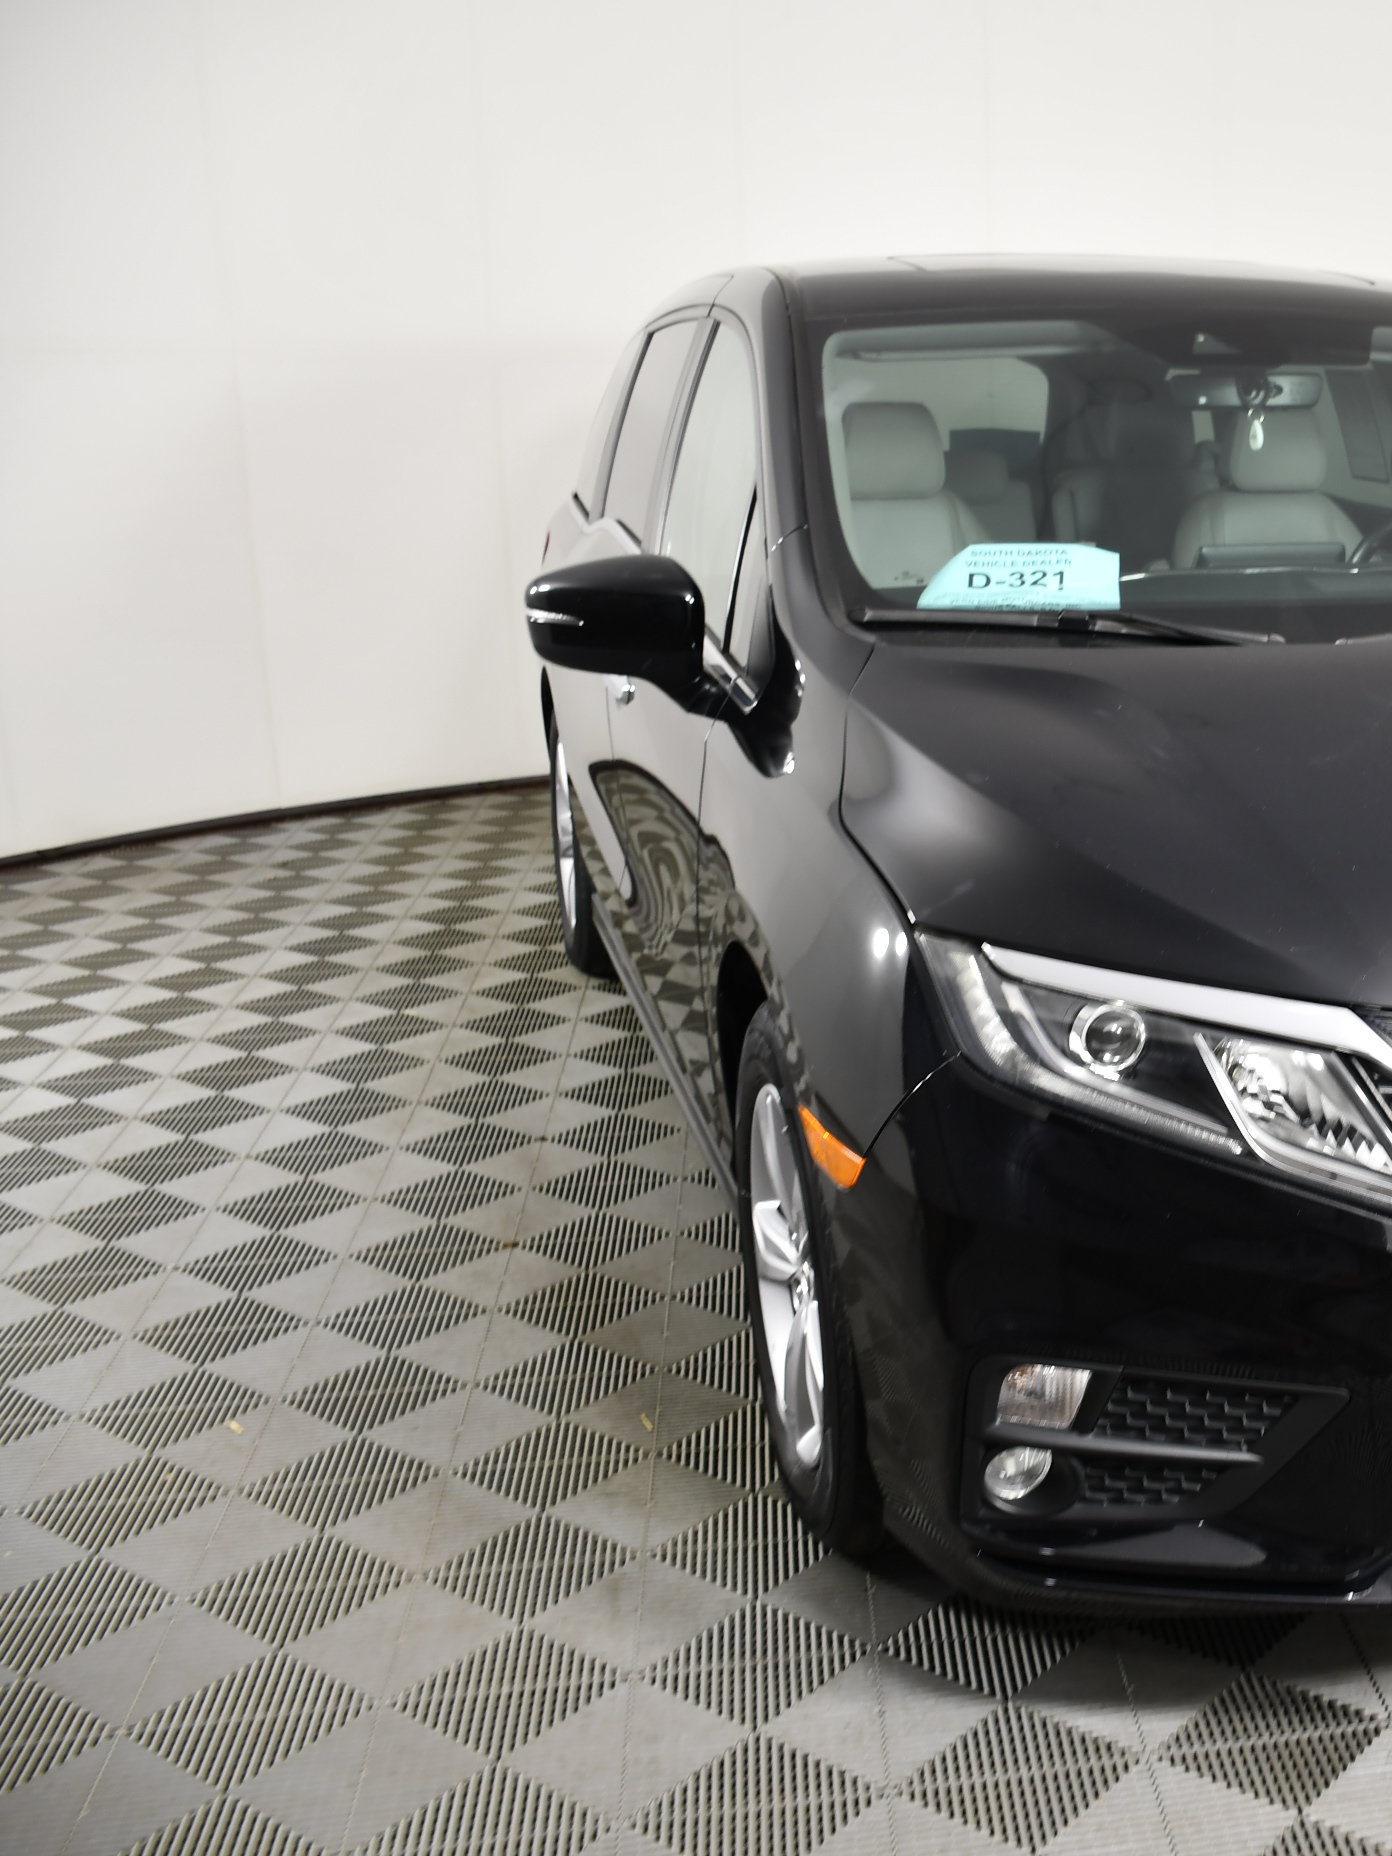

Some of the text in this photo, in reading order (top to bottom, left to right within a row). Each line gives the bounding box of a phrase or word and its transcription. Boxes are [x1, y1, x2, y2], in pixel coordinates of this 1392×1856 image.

[970, 548, 1068, 557] SOUTH DAKOTA
[965, 558, 1072, 568] VEHICLE DEALER
[967, 570, 1066, 590] D-321
